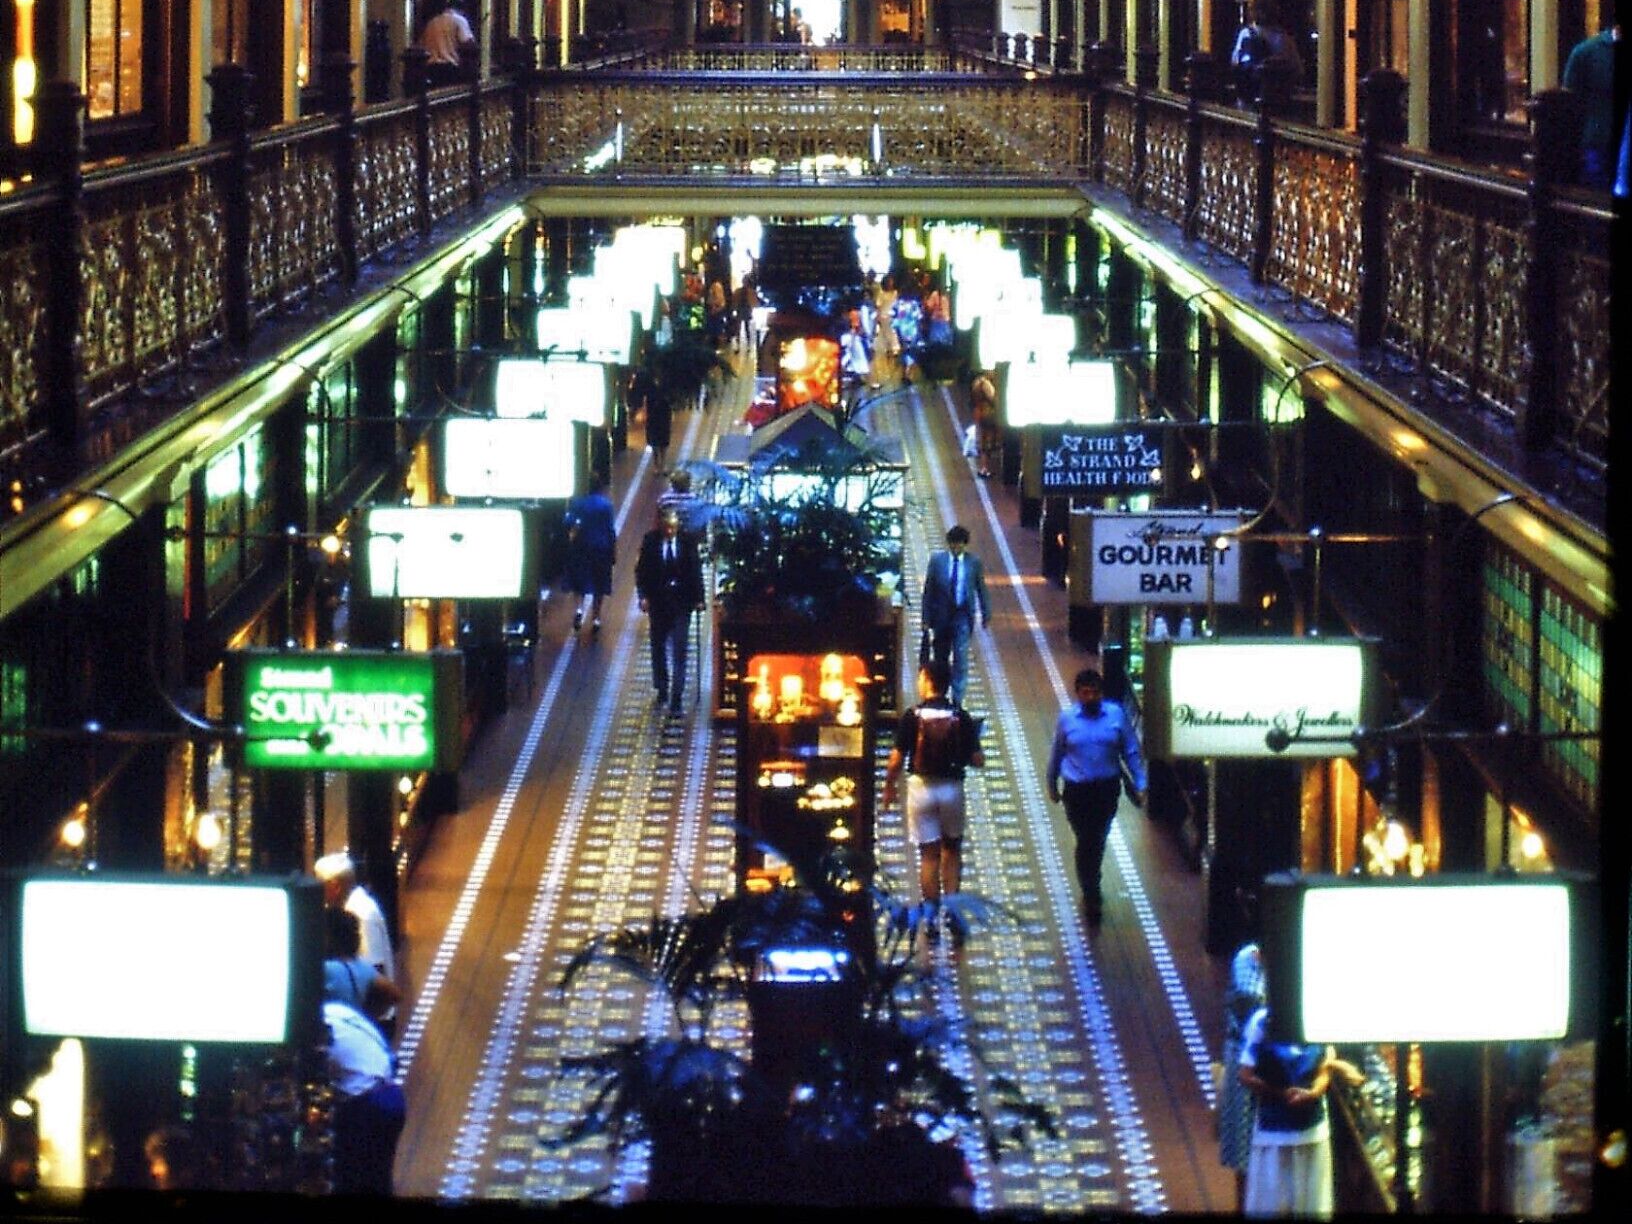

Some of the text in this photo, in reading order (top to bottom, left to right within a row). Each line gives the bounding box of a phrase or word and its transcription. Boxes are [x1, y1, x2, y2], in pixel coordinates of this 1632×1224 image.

[1086, 437, 1117, 451] THE
[1070, 454, 1136, 468] STRAND
[1044, 471, 1107, 485] HEALTH
[1099, 544, 1231, 566] GOURMET
[1139, 572, 1193, 594] BAR
[250, 690, 427, 724] SOUVENIRS
[1173, 703, 1269, 728] Watchmakers
